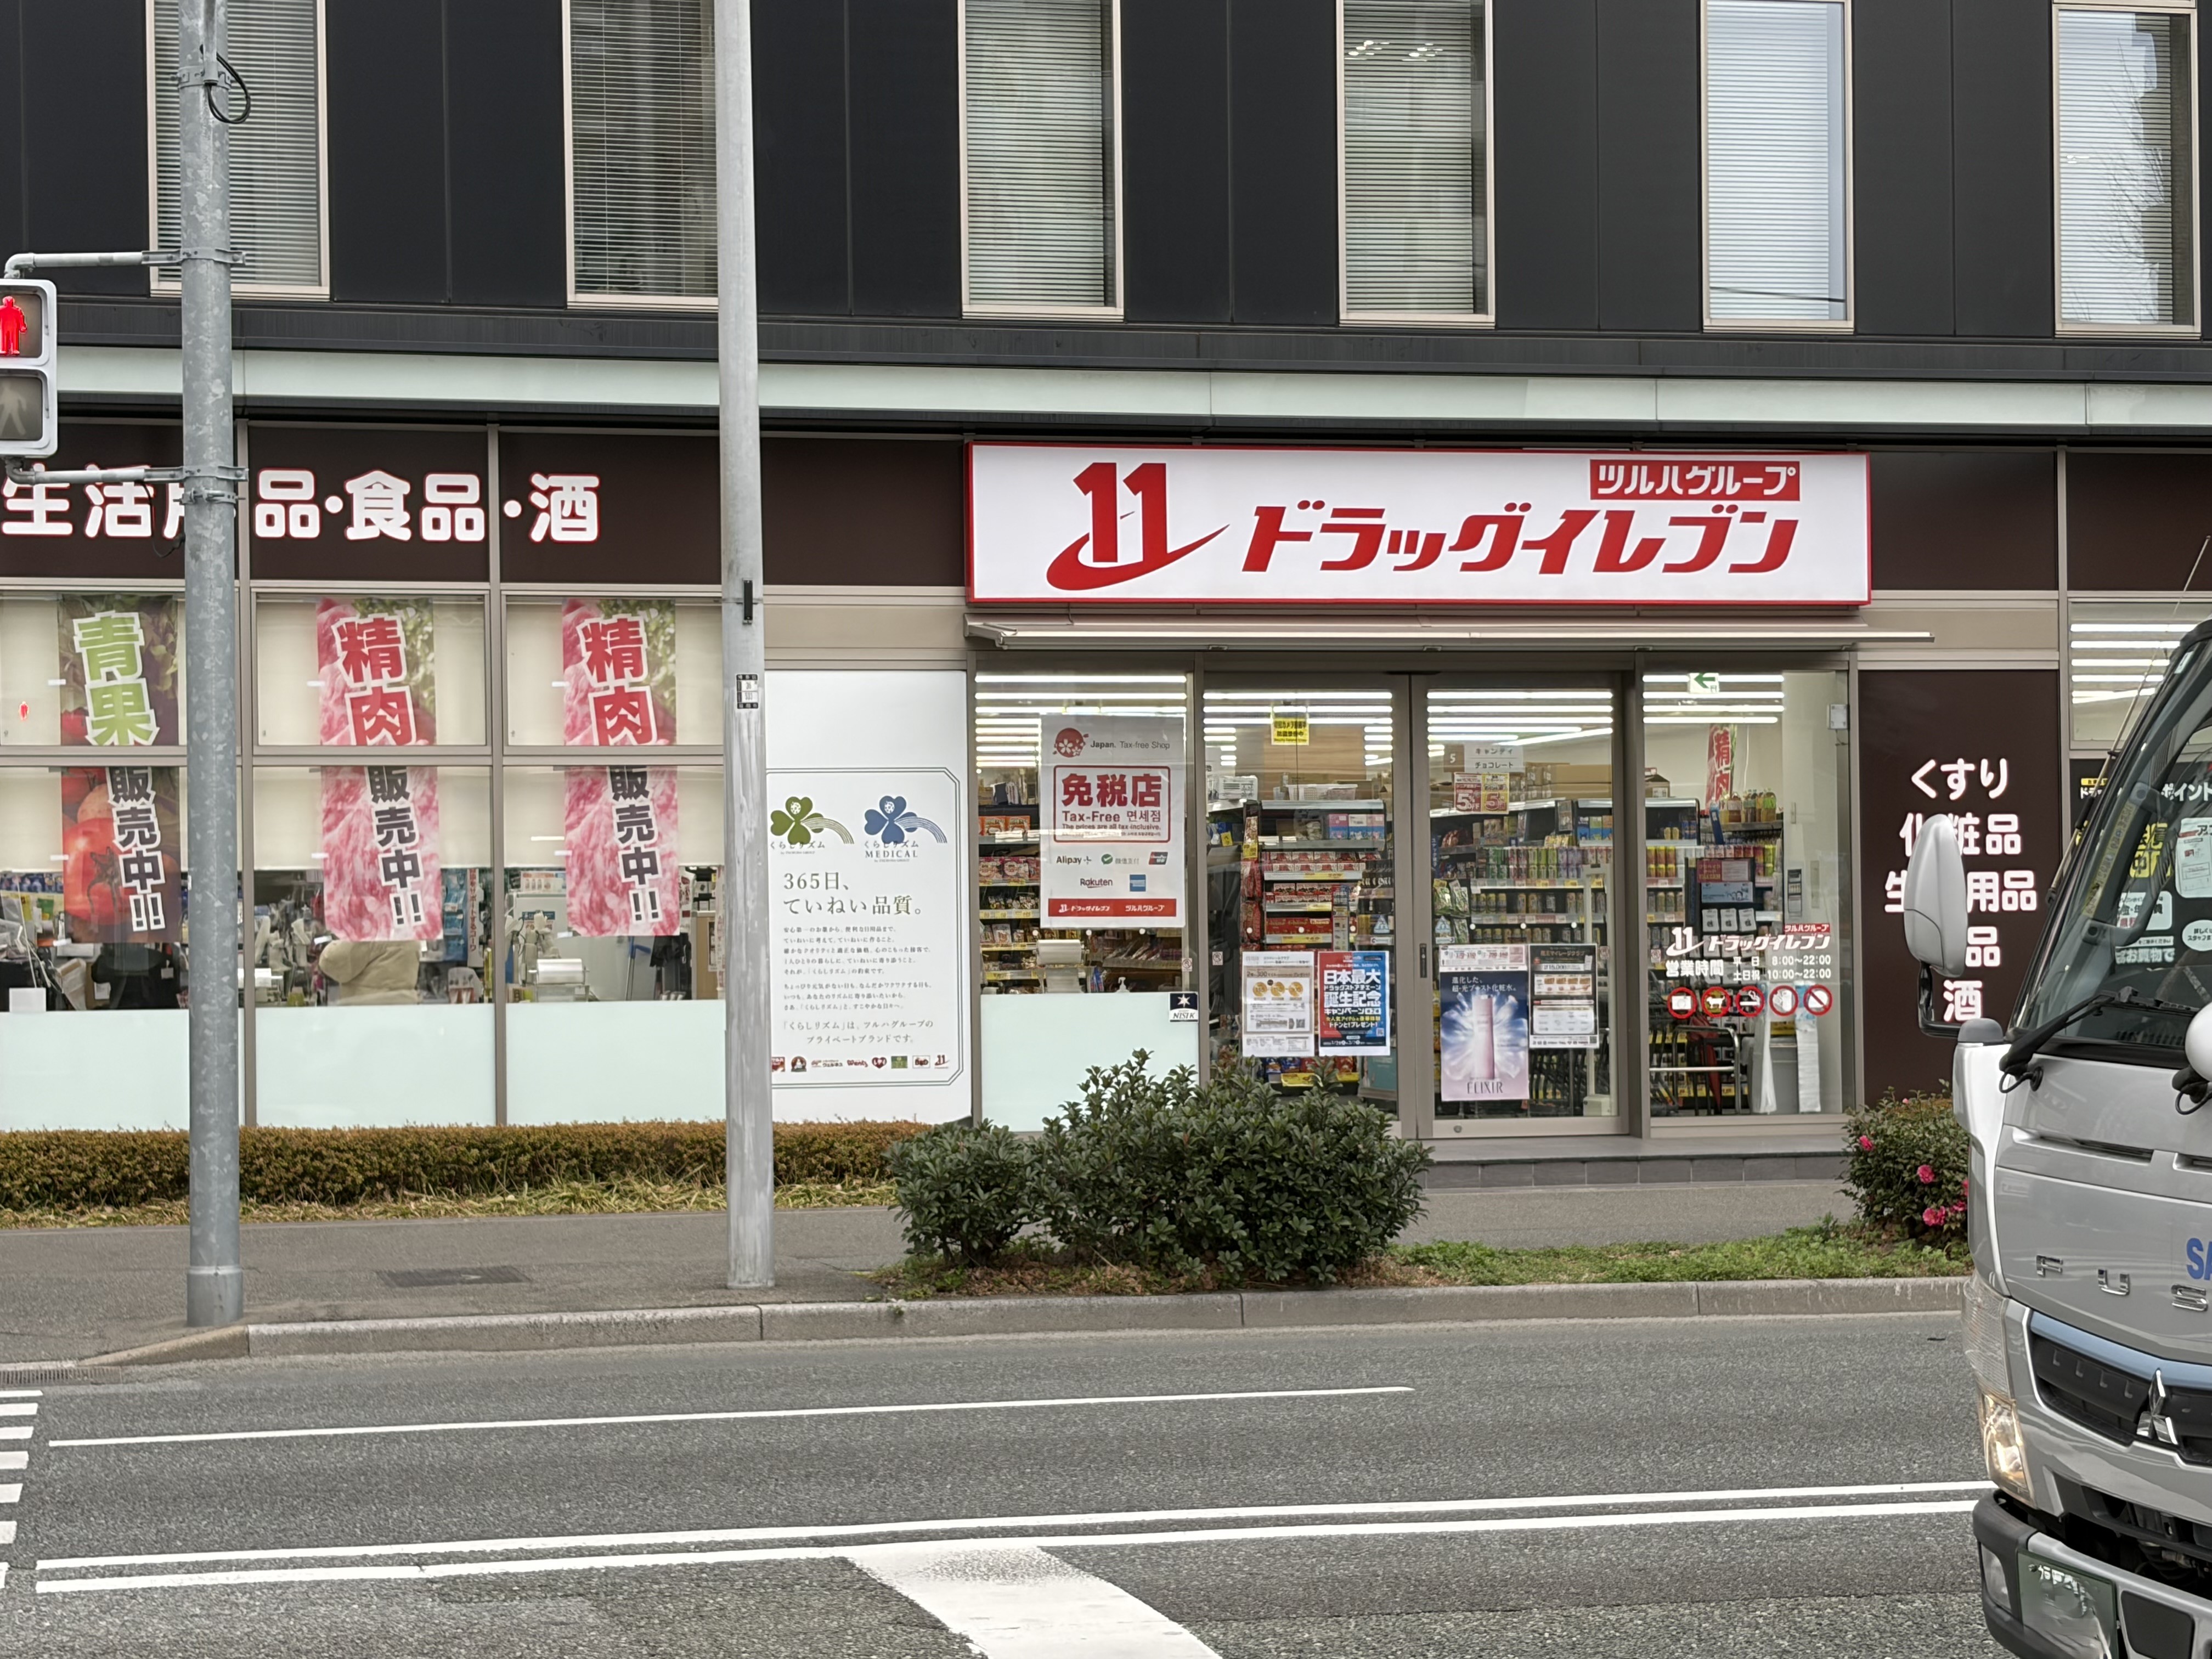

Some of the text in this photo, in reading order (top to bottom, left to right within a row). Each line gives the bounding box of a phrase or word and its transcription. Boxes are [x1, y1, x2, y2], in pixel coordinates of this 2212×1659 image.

[1598, 465, 1797, 496] ツルハグループ
[1242, 500, 1799, 575] ドラッグイレブン
[331, 612, 417, 745] 精肉
[576, 613, 658, 745] 精肉
[1090, 741, 1116, 749] Japan.
[1152, 741, 1170, 750] Shop
[1449, 753, 1455, 763] 5
[1911, 758, 2008, 800] くすり
[1062, 774, 1162, 807] 免税店
[1062, 811, 1120, 822] Tax-Free
[1126, 810, 1161, 822] 면세점
[783, 872, 849, 890] 365日、
[1080, 878, 1113, 887] Rakuten
[1884, 870, 2038, 913] 生用品
[783, 895, 921, 915] ていねい品質。
[1785, 924, 1830, 933] ツルハグループ
[1708, 934, 1831, 951] ドラッグイレブン
[1665, 959, 1724, 977] 営業時間
[1733, 969, 1760, 981] 土日祝
[1323, 969, 1381, 985] 日本最大
[1324, 991, 1382, 1007] 誕生記念
[1943, 980, 1983, 1022] 酒
[1466, 1081, 1503, 1094] ELIXIR
